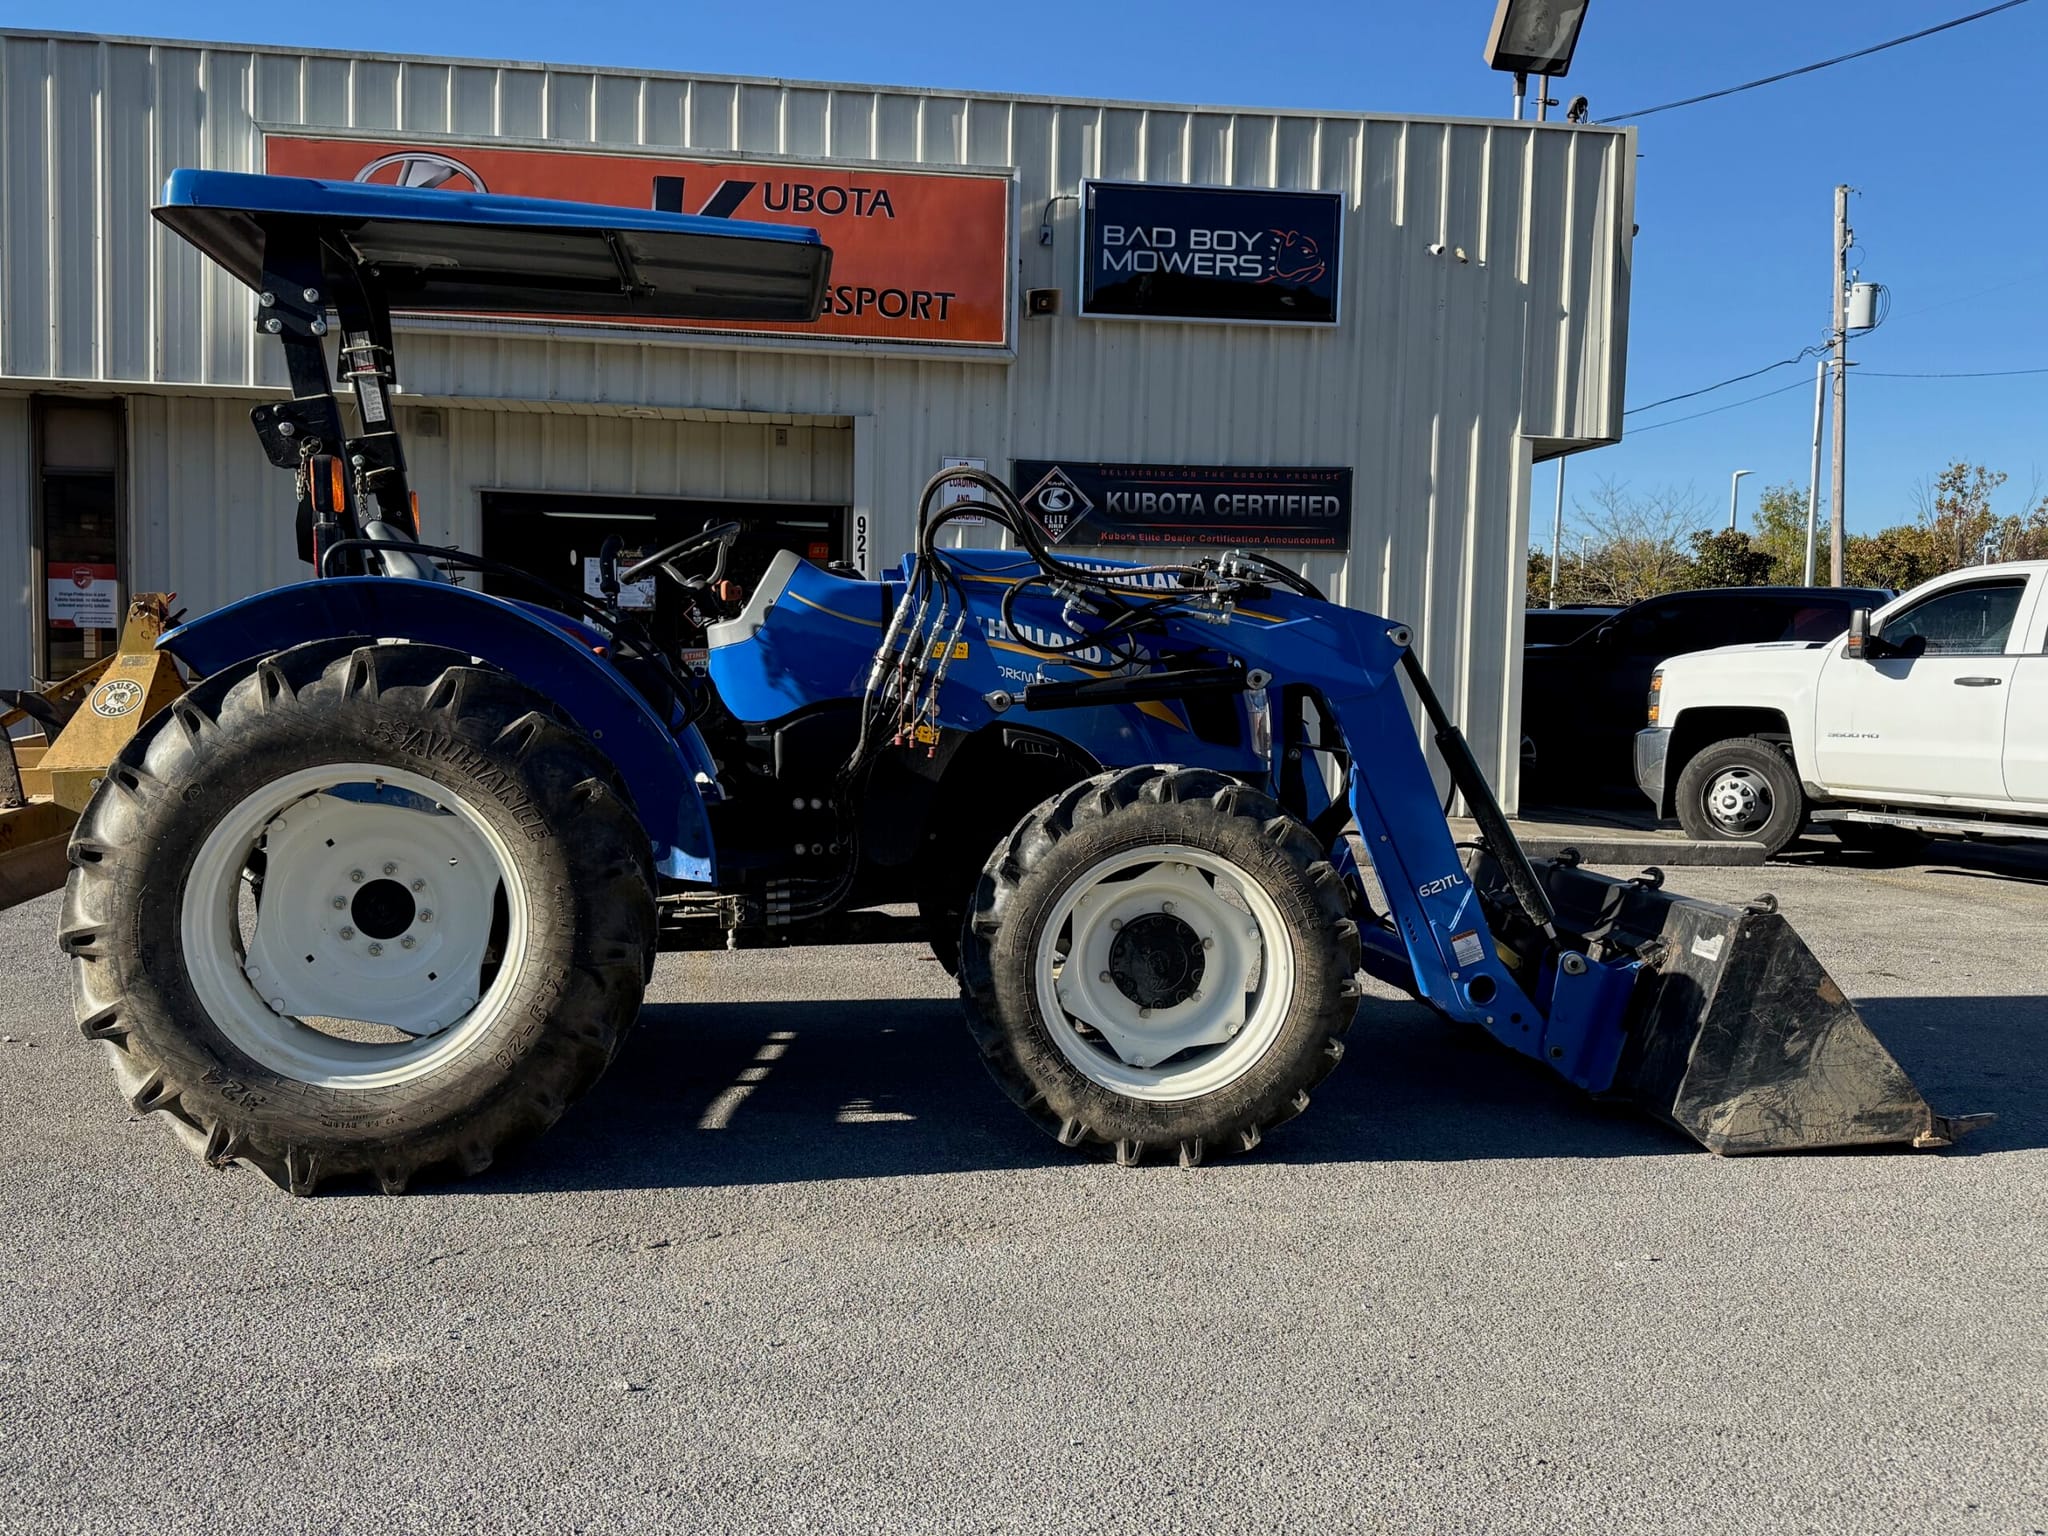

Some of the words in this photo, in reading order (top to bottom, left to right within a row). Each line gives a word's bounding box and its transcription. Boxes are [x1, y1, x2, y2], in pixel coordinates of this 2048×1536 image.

[1103, 225, 1176, 248] BAD
[1190, 229, 1263, 252] BOY
[1102, 249, 1263, 277] MOWERS
[1106, 491, 1206, 516] KUBOTA
[1213, 493, 1341, 518] CERTIFIED
[1044, 514, 1068, 525] ELITE
[857, 516, 867, 572] 921
[1101, 531, 1136, 540] Kubota
[1138, 532, 1160, 542] Elite
[1164, 533, 1195, 542] Dealer
[1199, 533, 1260, 544] Certification
[1264, 535, 1335, 545] Announcement
[107, 681, 138, 694] BUSH
[99, 703, 126, 714] HOG
[400, 726, 552, 844] ALLIANCE
[1419, 873, 1464, 897] 621TL
